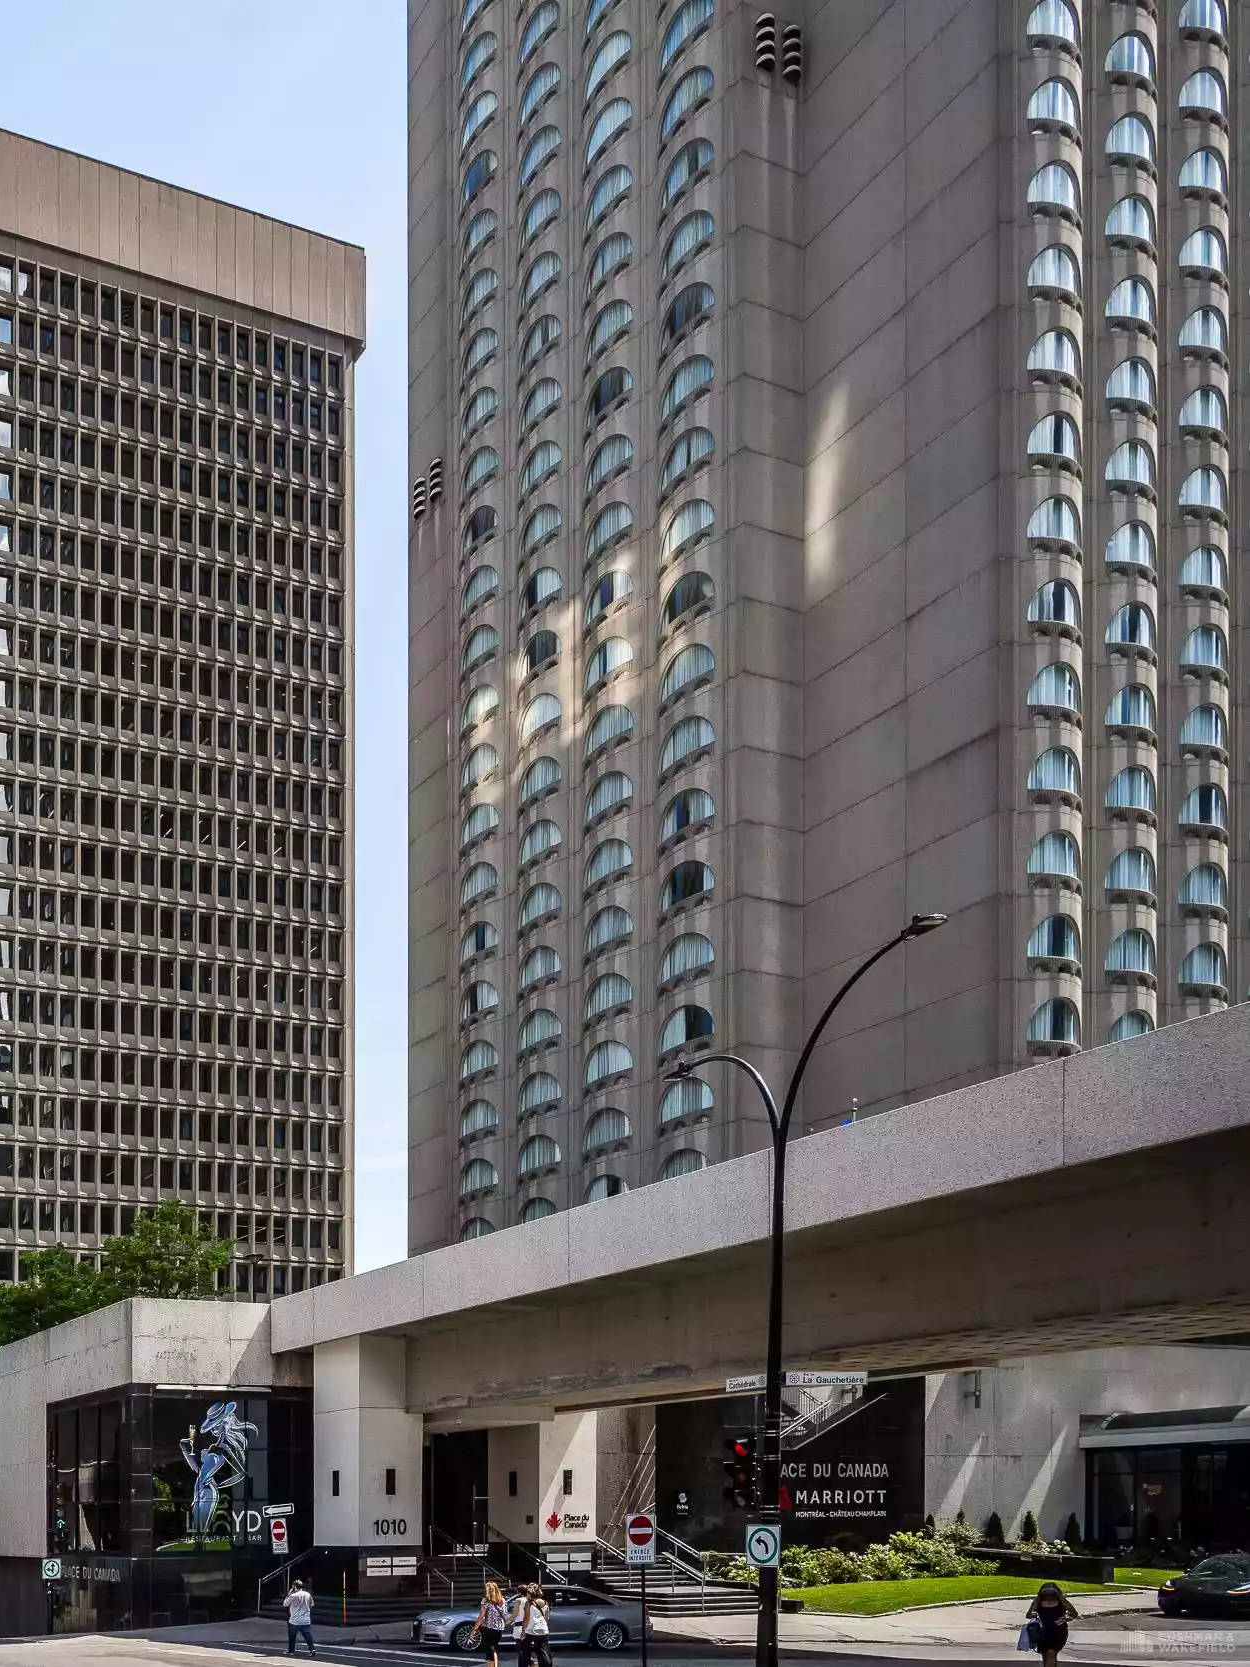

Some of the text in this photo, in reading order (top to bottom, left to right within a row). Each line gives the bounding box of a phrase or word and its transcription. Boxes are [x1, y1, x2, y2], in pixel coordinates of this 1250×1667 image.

[803, 1375, 864, 1384] La Gauchetière
[728, 1380, 756, 1389] Cathédrale
[780, 1463, 889, 1478] ACE DU CANADA
[795, 1490, 887, 1504] MARRIOTT
[564, 1513, 581, 1522] Place
[795, 1510, 826, 1518] MONTRÉAL
[830, 1509, 855, 1518] CHÂTEAU
[373, 1519, 407, 1536] 1010
[563, 1521, 587, 1529] Canada
[82, 1566, 92, 1579] DU
